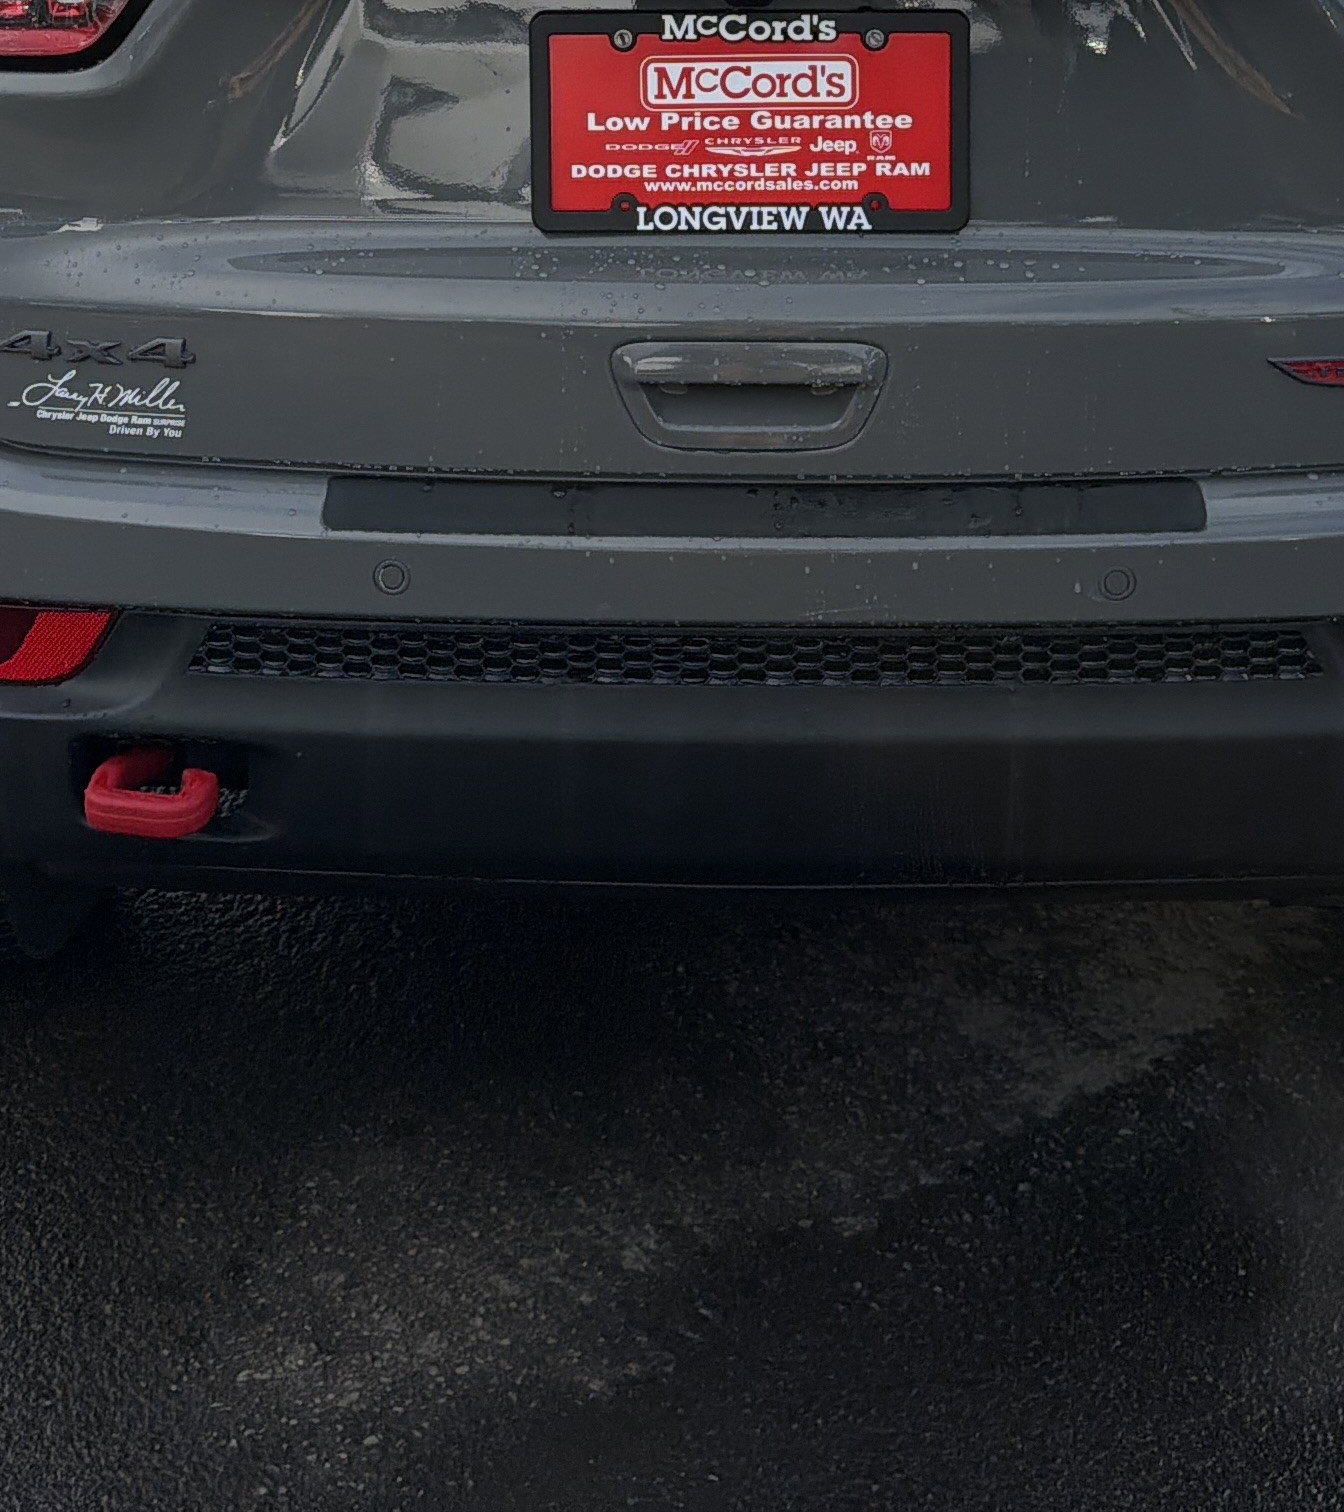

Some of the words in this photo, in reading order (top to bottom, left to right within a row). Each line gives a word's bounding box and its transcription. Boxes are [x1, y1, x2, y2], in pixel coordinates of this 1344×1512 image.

[661, 14, 837, 41] McCord's
[653, 65, 845, 100] McCord's
[587, 112, 650, 131] Low
[661, 112, 741, 131] Price
[750, 110, 913, 131] Guarantee
[705, 136, 801, 145] CHRYSLER
[809, 136, 858, 155] Jeep
[571, 164, 657, 179] DODGE
[665, 163, 797, 178] CHRYSLER
[804, 162, 867, 176] JEEP
[875, 162, 931, 176] RAM
[644, 177, 859, 192] www.mccordsales.com
[636, 206, 810, 231] LONGVIEW
[818, 206, 872, 230] WA
[36, 409, 75, 420] Chrysler
[75, 412, 99, 423] Jeep
[99, 414, 129, 424] Dodge
[130, 415, 152, 425] Ram
[109, 425, 143, 435] Driven
[145, 427, 160, 438] By
[163, 428, 182, 437] You
